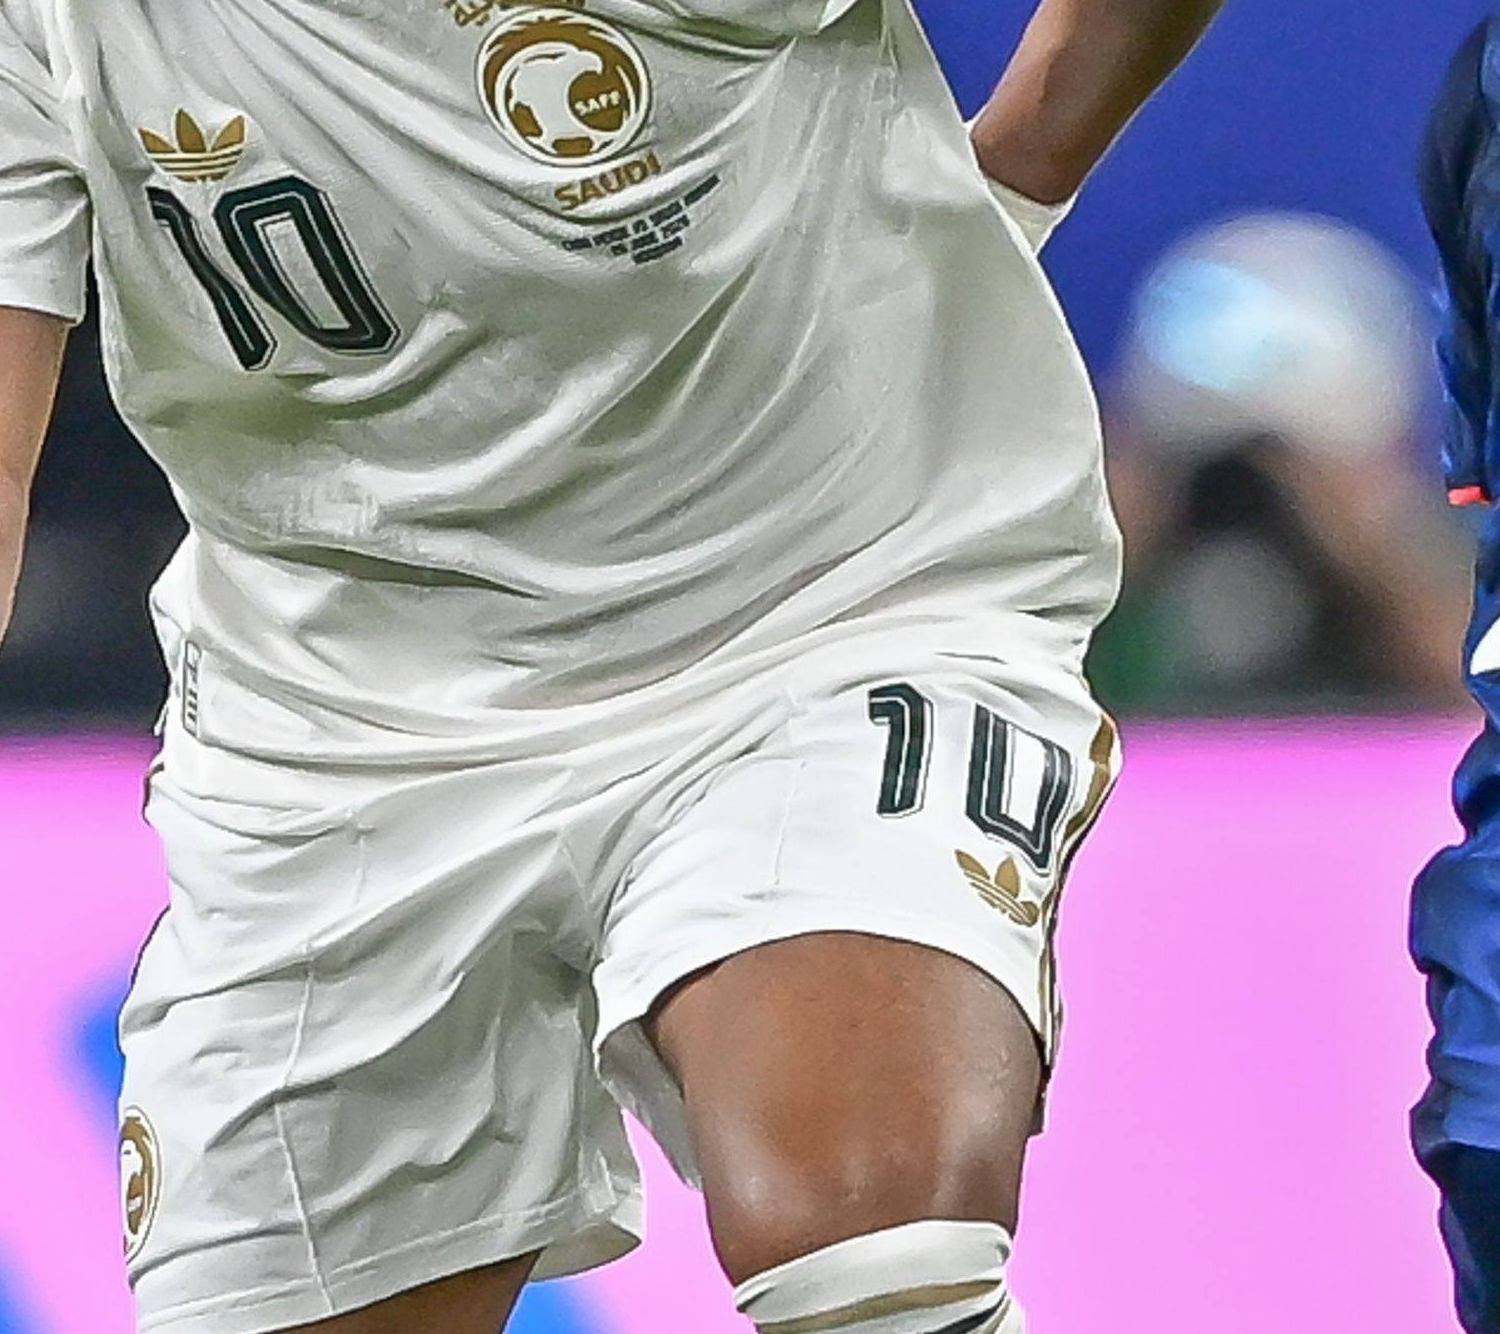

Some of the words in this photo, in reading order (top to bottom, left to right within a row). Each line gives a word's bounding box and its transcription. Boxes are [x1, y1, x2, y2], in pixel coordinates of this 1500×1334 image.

[144, 171, 402, 373] 10
[553, 151, 662, 211] SAUDI
[866, 679, 1079, 879] 10
